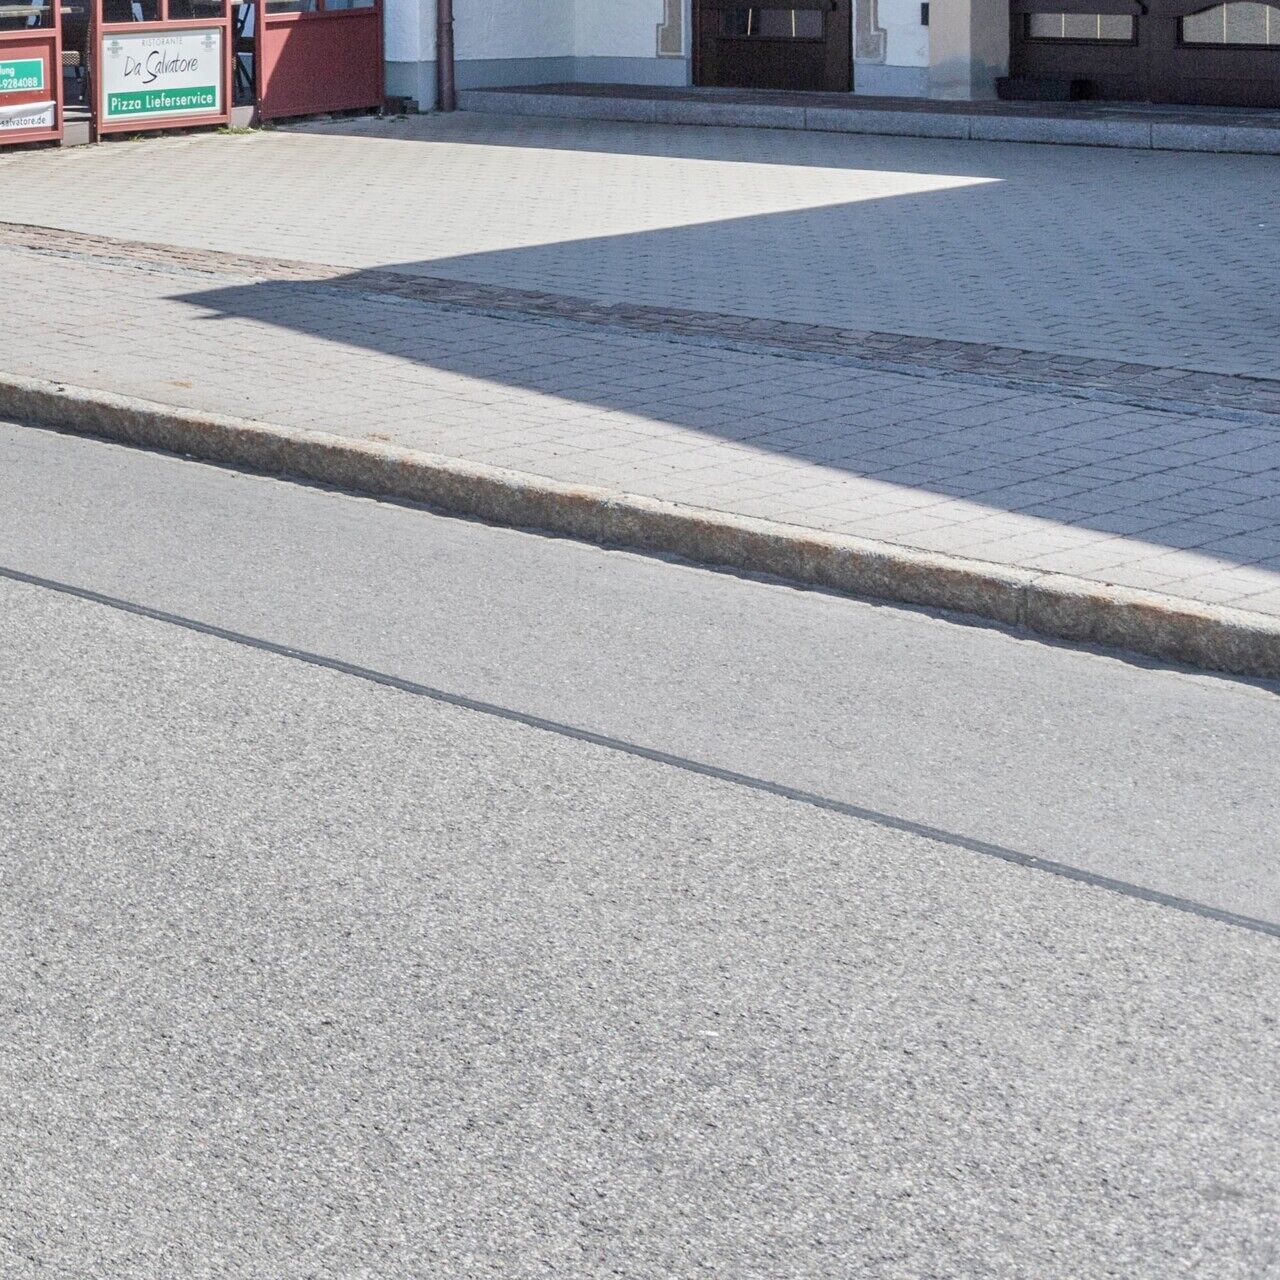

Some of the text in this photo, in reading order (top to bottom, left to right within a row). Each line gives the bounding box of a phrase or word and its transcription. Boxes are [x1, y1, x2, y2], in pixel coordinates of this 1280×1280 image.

[142, 37, 183, 47] RISTORANTE
[124, 50, 198, 84] Da Salvatore
[111, 92, 213, 111] Pizza Lieferservice
